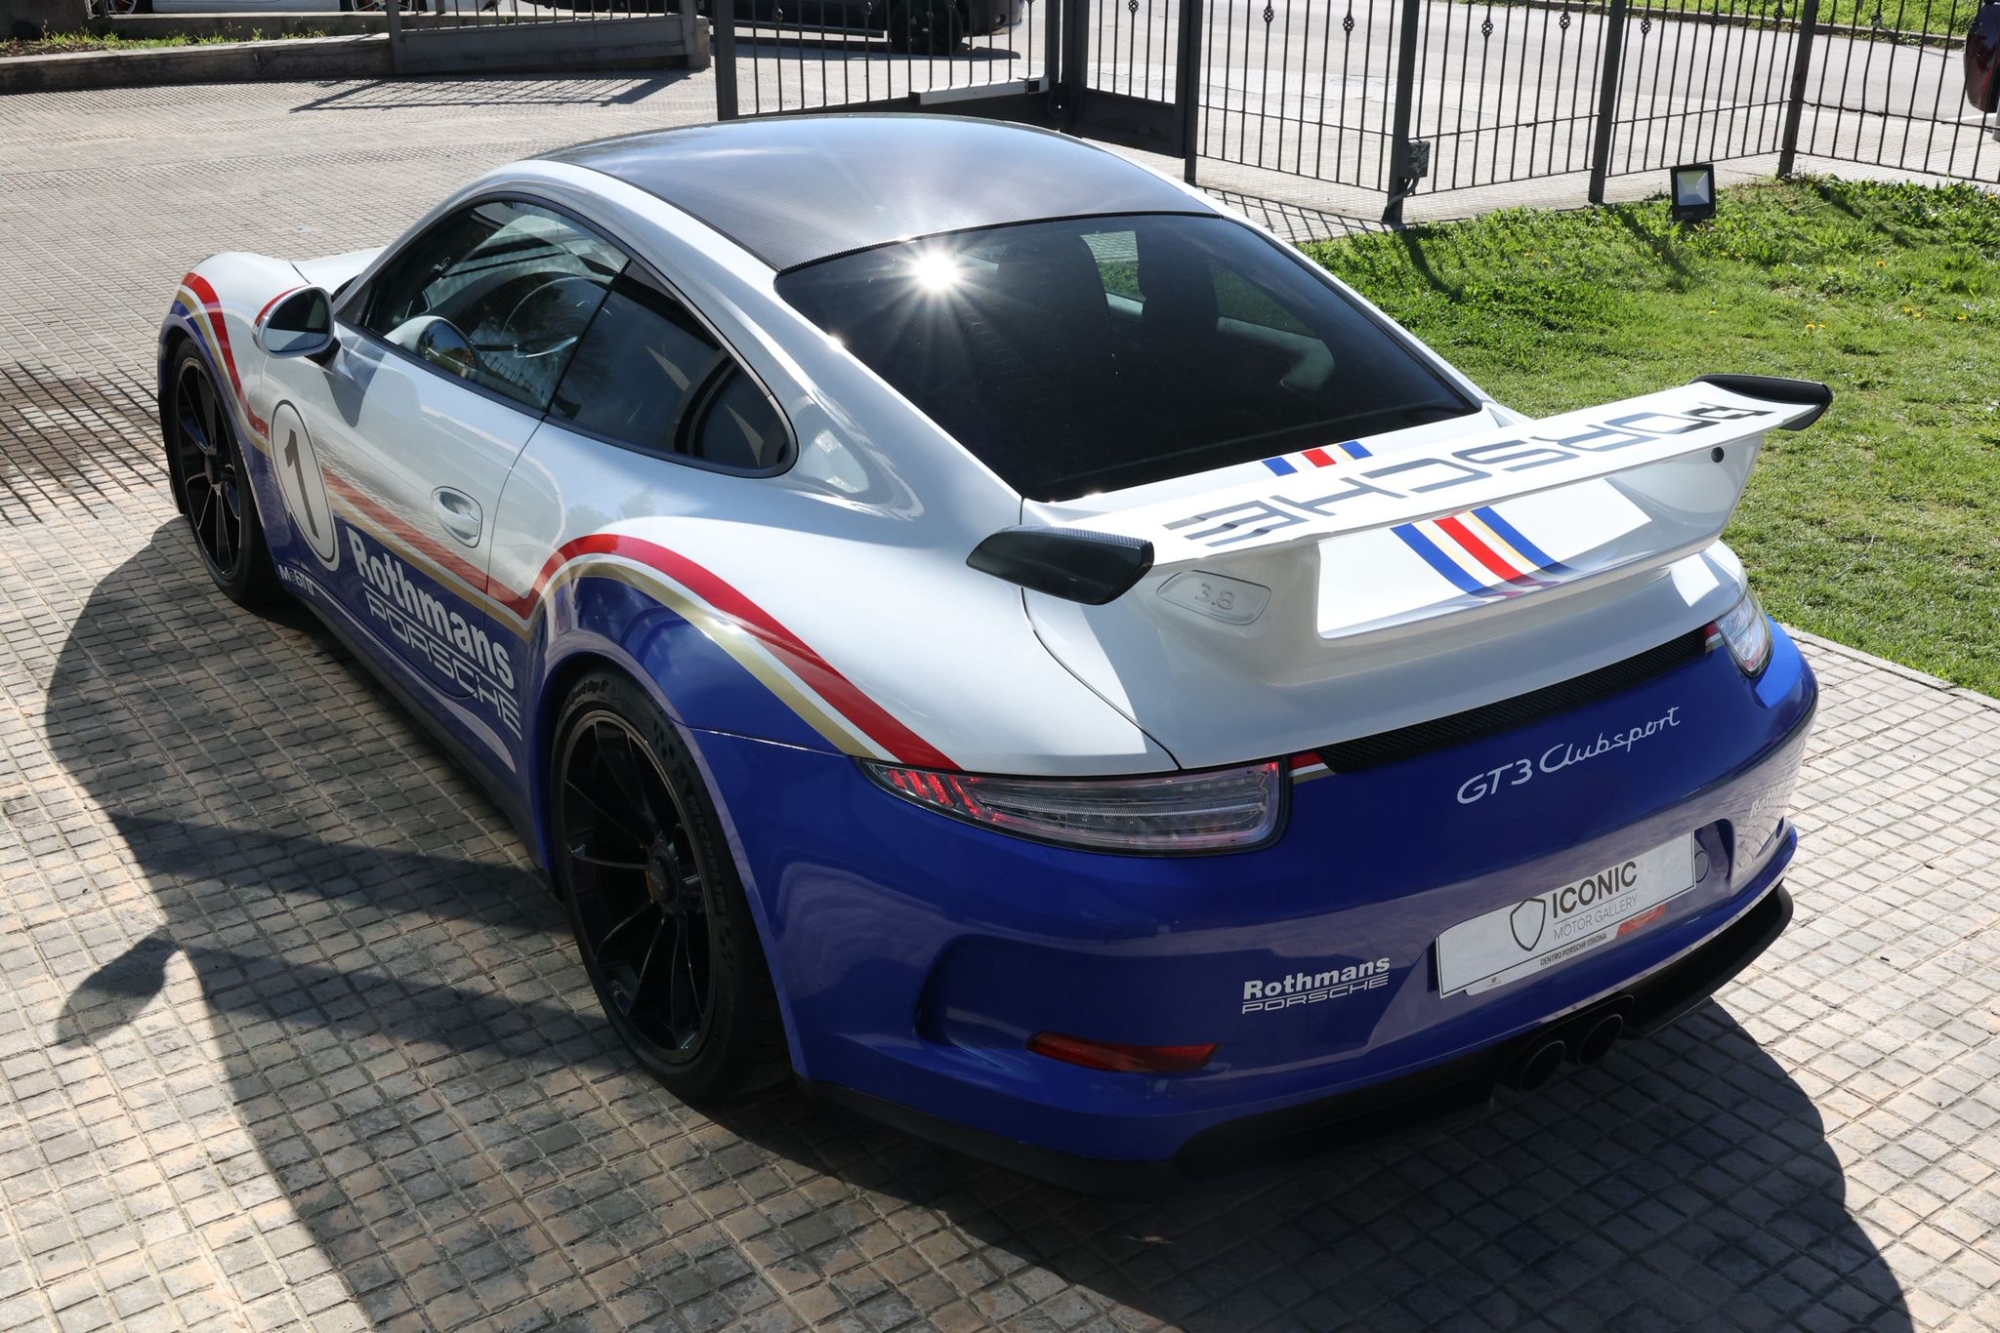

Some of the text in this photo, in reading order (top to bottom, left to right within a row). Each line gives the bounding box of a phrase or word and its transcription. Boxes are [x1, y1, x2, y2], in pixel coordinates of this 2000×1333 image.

[284, 428, 320, 539] 1
[1163, 402, 1776, 548] PORSCHE
[346, 526, 515, 690] Rothmans
[1195, 583, 1234, 610] 3.8
[365, 591, 522, 741] PORSCHE
[1457, 706, 1681, 804] GT3 Clubsport
[1552, 861, 1637, 919] ICONIC
[1554, 894, 1638, 940] MOTOR GALLERY
[1243, 957, 1391, 1000] Rothmans
[1540, 951, 1562, 966] CENTRO
[1562, 940, 1587, 957] PORSCHE
[1242, 975, 1389, 1014] PORSCHE
